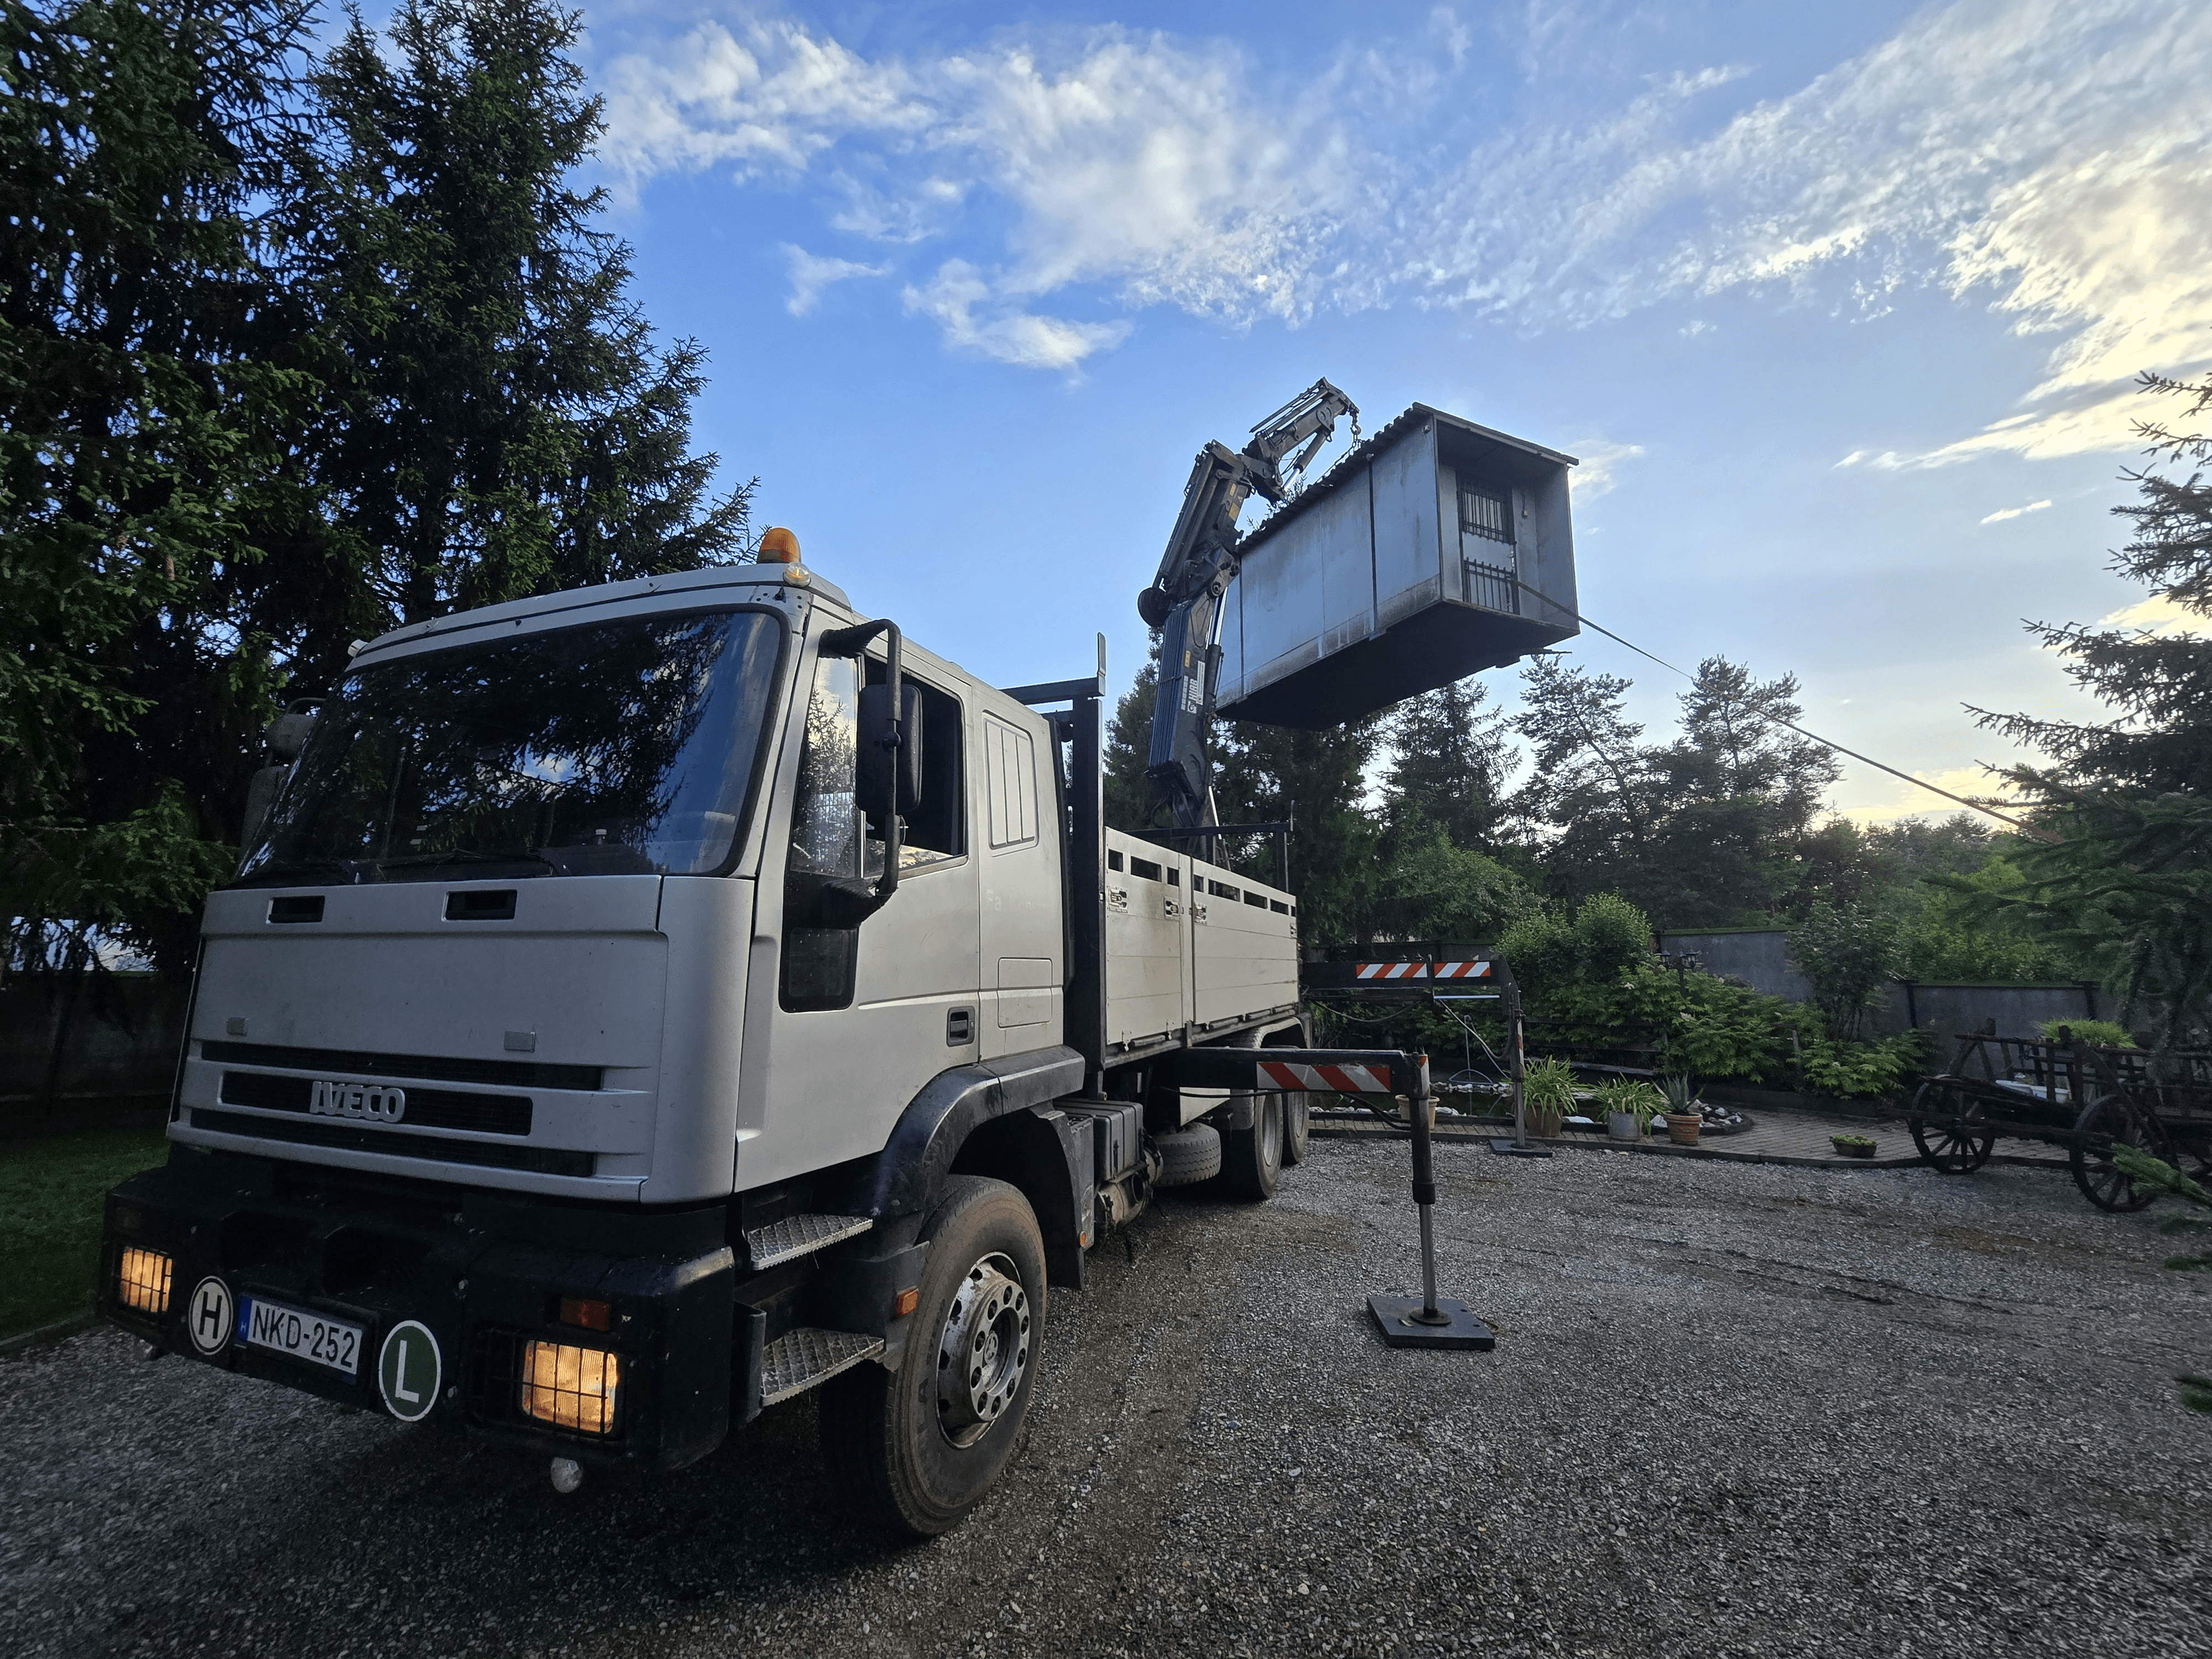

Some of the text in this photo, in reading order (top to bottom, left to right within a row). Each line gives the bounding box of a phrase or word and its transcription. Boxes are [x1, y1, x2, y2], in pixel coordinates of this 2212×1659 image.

[1188, 678, 1198, 703] HIAB
[310, 1081, 405, 1123] IVECO
[199, 1291, 222, 1339] H
[252, 1305, 356, 1368] NKD-252
[395, 1339, 420, 1404] L
